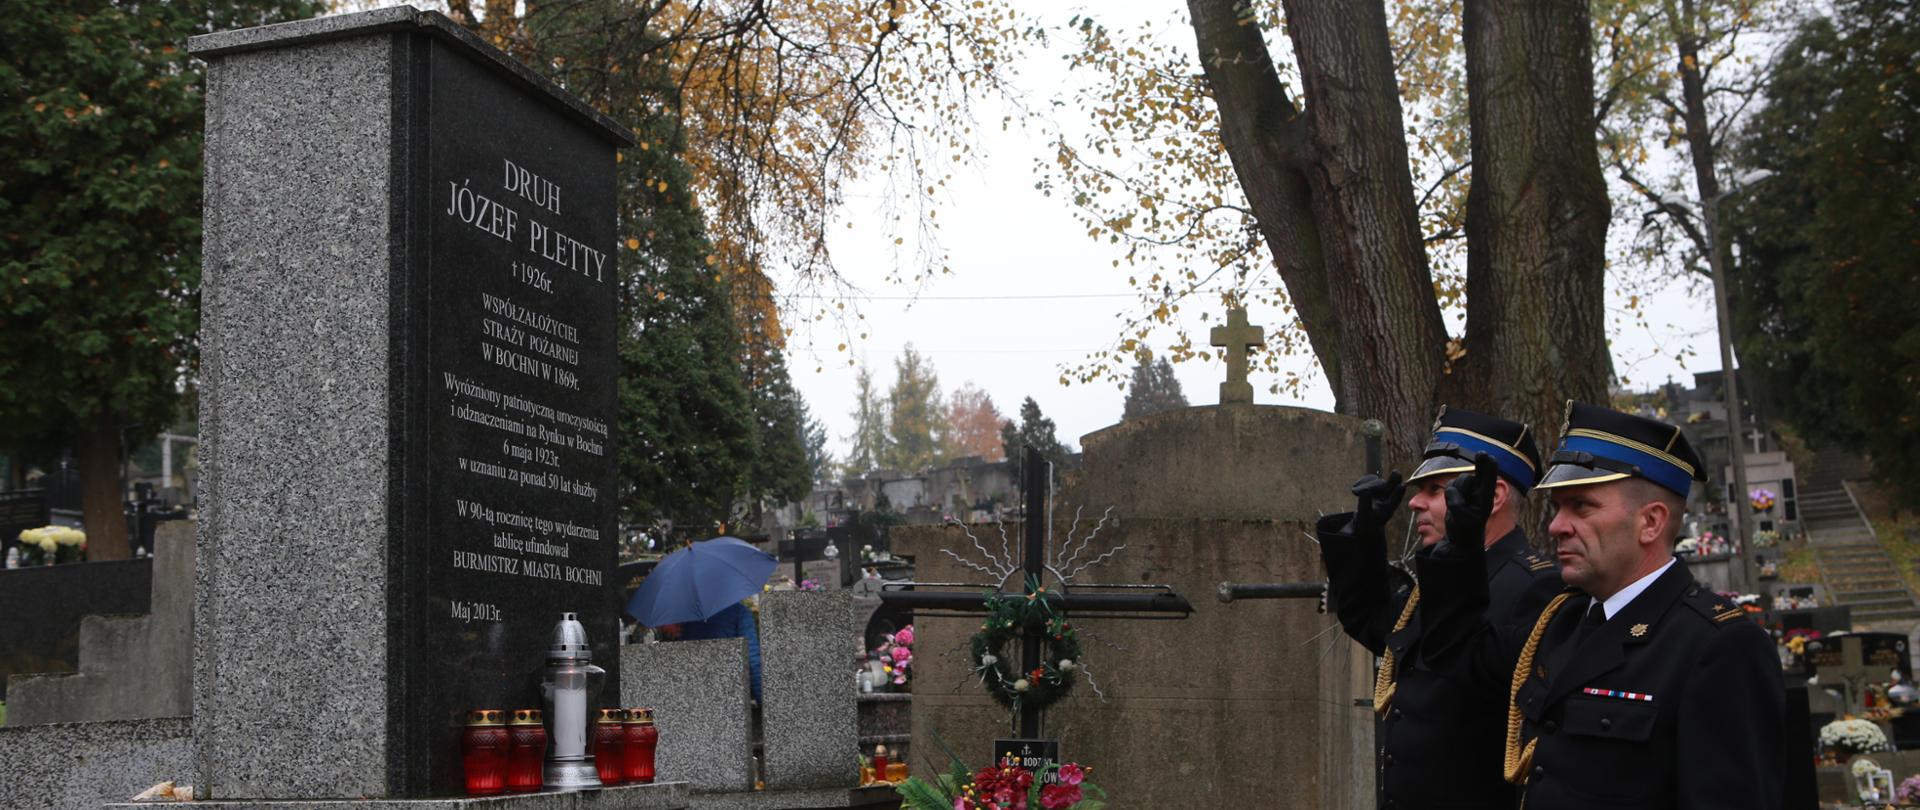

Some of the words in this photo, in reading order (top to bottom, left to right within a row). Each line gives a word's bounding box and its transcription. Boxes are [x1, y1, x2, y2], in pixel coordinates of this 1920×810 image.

[504, 158, 561, 215] DRUH
[447, 178, 519, 242] JÓZEF
[529, 219, 607, 282] PLETTY
[521, 262, 554, 294] 1926r.
[483, 318, 525, 346] STRAŻY
[529, 334, 579, 366] POŻARNEJ
[482, 342, 493, 361] W
[495, 347, 539, 378] BOCHNI
[541, 362, 552, 381] W
[554, 367, 580, 391] 1869r.
[444, 372, 501, 407] Wyróżniony
[503, 394, 556, 424] patriotyczną
[556, 410, 608, 439] uroczystością
[450, 399, 455, 417] i
[457, 403, 525, 435] odznaczeniami
[526, 425, 537, 438] na
[539, 424, 565, 445] Rynku
[566, 435, 575, 448] w
[576, 434, 603, 456] Bochni
[503, 438, 509, 455] 6
[511, 443, 533, 464] maja
[535, 446, 561, 468] 1923r.
[458, 457, 467, 470] w
[470, 461, 507, 479] uznaniu
[508, 468, 519, 481] za
[520, 471, 546, 488] ponad
[548, 473, 559, 490] 50
[560, 476, 571, 493] lat
[572, 479, 598, 503] służby
[457, 499, 468, 518] W
[470, 501, 495, 526] 90-tą
[496, 510, 533, 532] rocznicę
[535, 516, 553, 536] tego
[555, 520, 600, 541] wydarzenia
[493, 531, 524, 555] tablicę
[525, 536, 569, 558] ufundował
[453, 550, 519, 575] BURMISTRZ
[523, 560, 562, 581] MIASTA
[565, 566, 602, 587] BOCHNI
[451, 601, 471, 623] Maj
[473, 602, 502, 621] 2013r.
